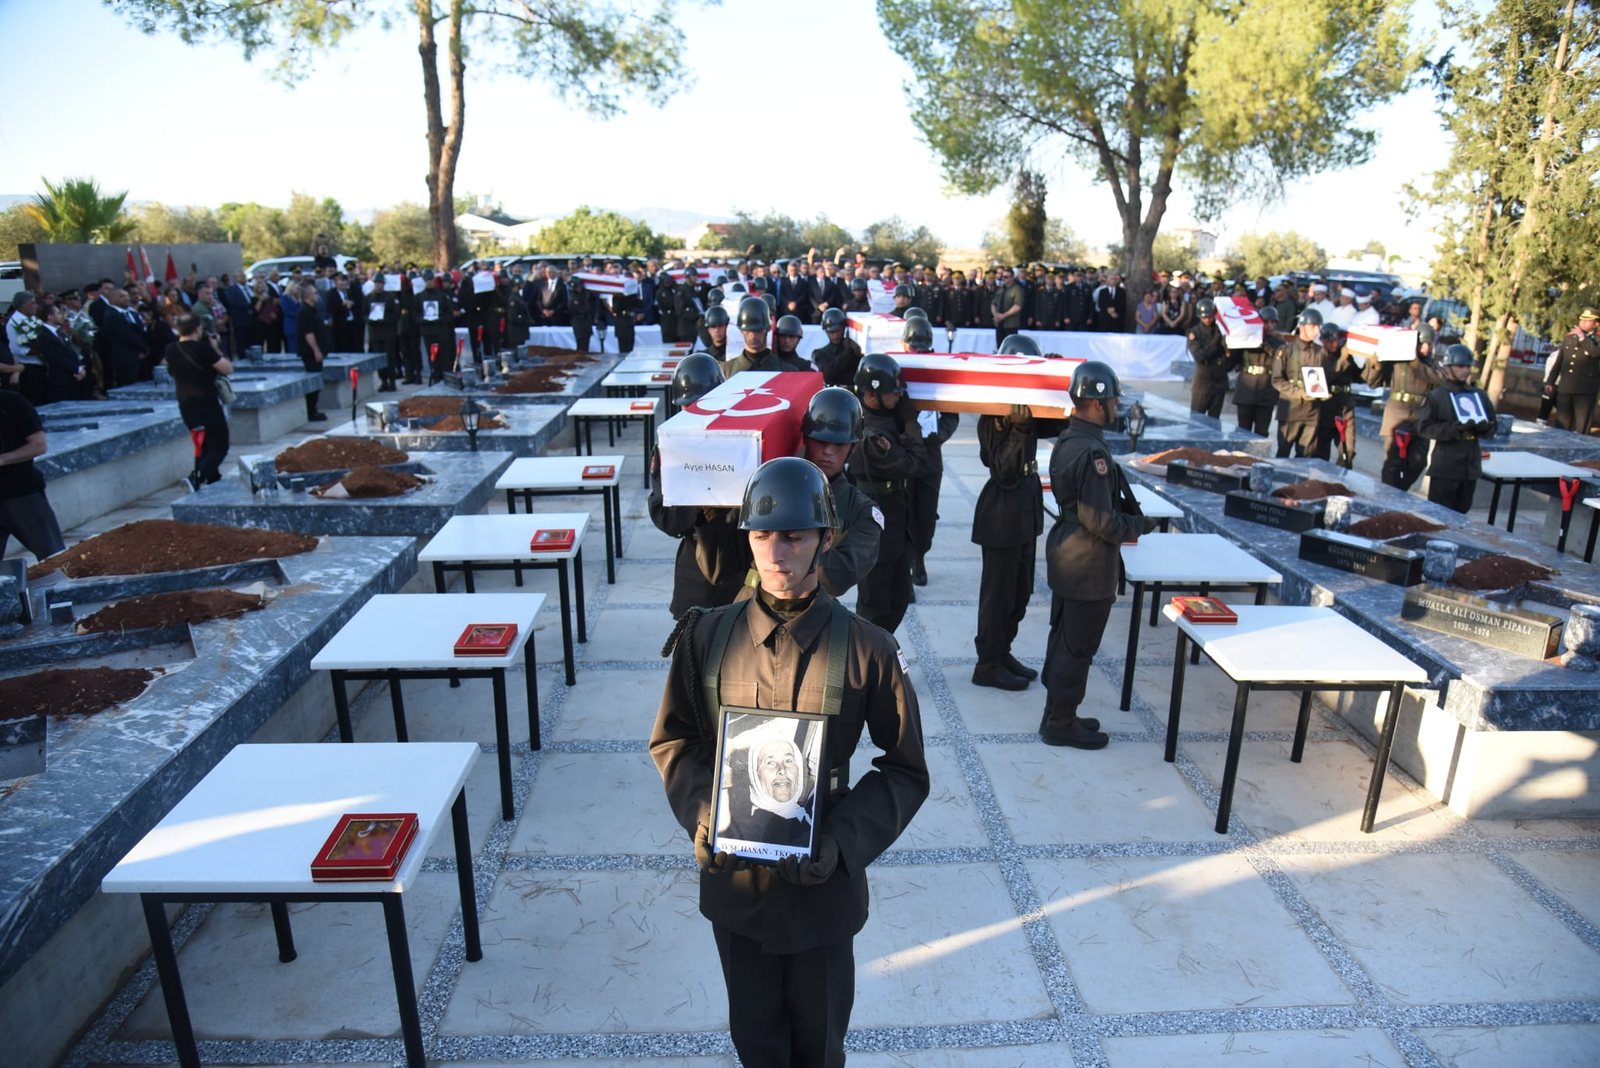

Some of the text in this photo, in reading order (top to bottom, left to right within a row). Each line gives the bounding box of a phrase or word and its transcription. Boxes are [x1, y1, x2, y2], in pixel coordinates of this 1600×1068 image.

[683, 462, 735, 473] Ayşe HASAN
[1417, 598, 1451, 613] MUALLA
[1453, 604, 1467, 618] ALİ
[1469, 611, 1501, 627] OSMAN
[1473, 626, 1491, 638] 1974
[740, 844, 768, 855] HASAN
